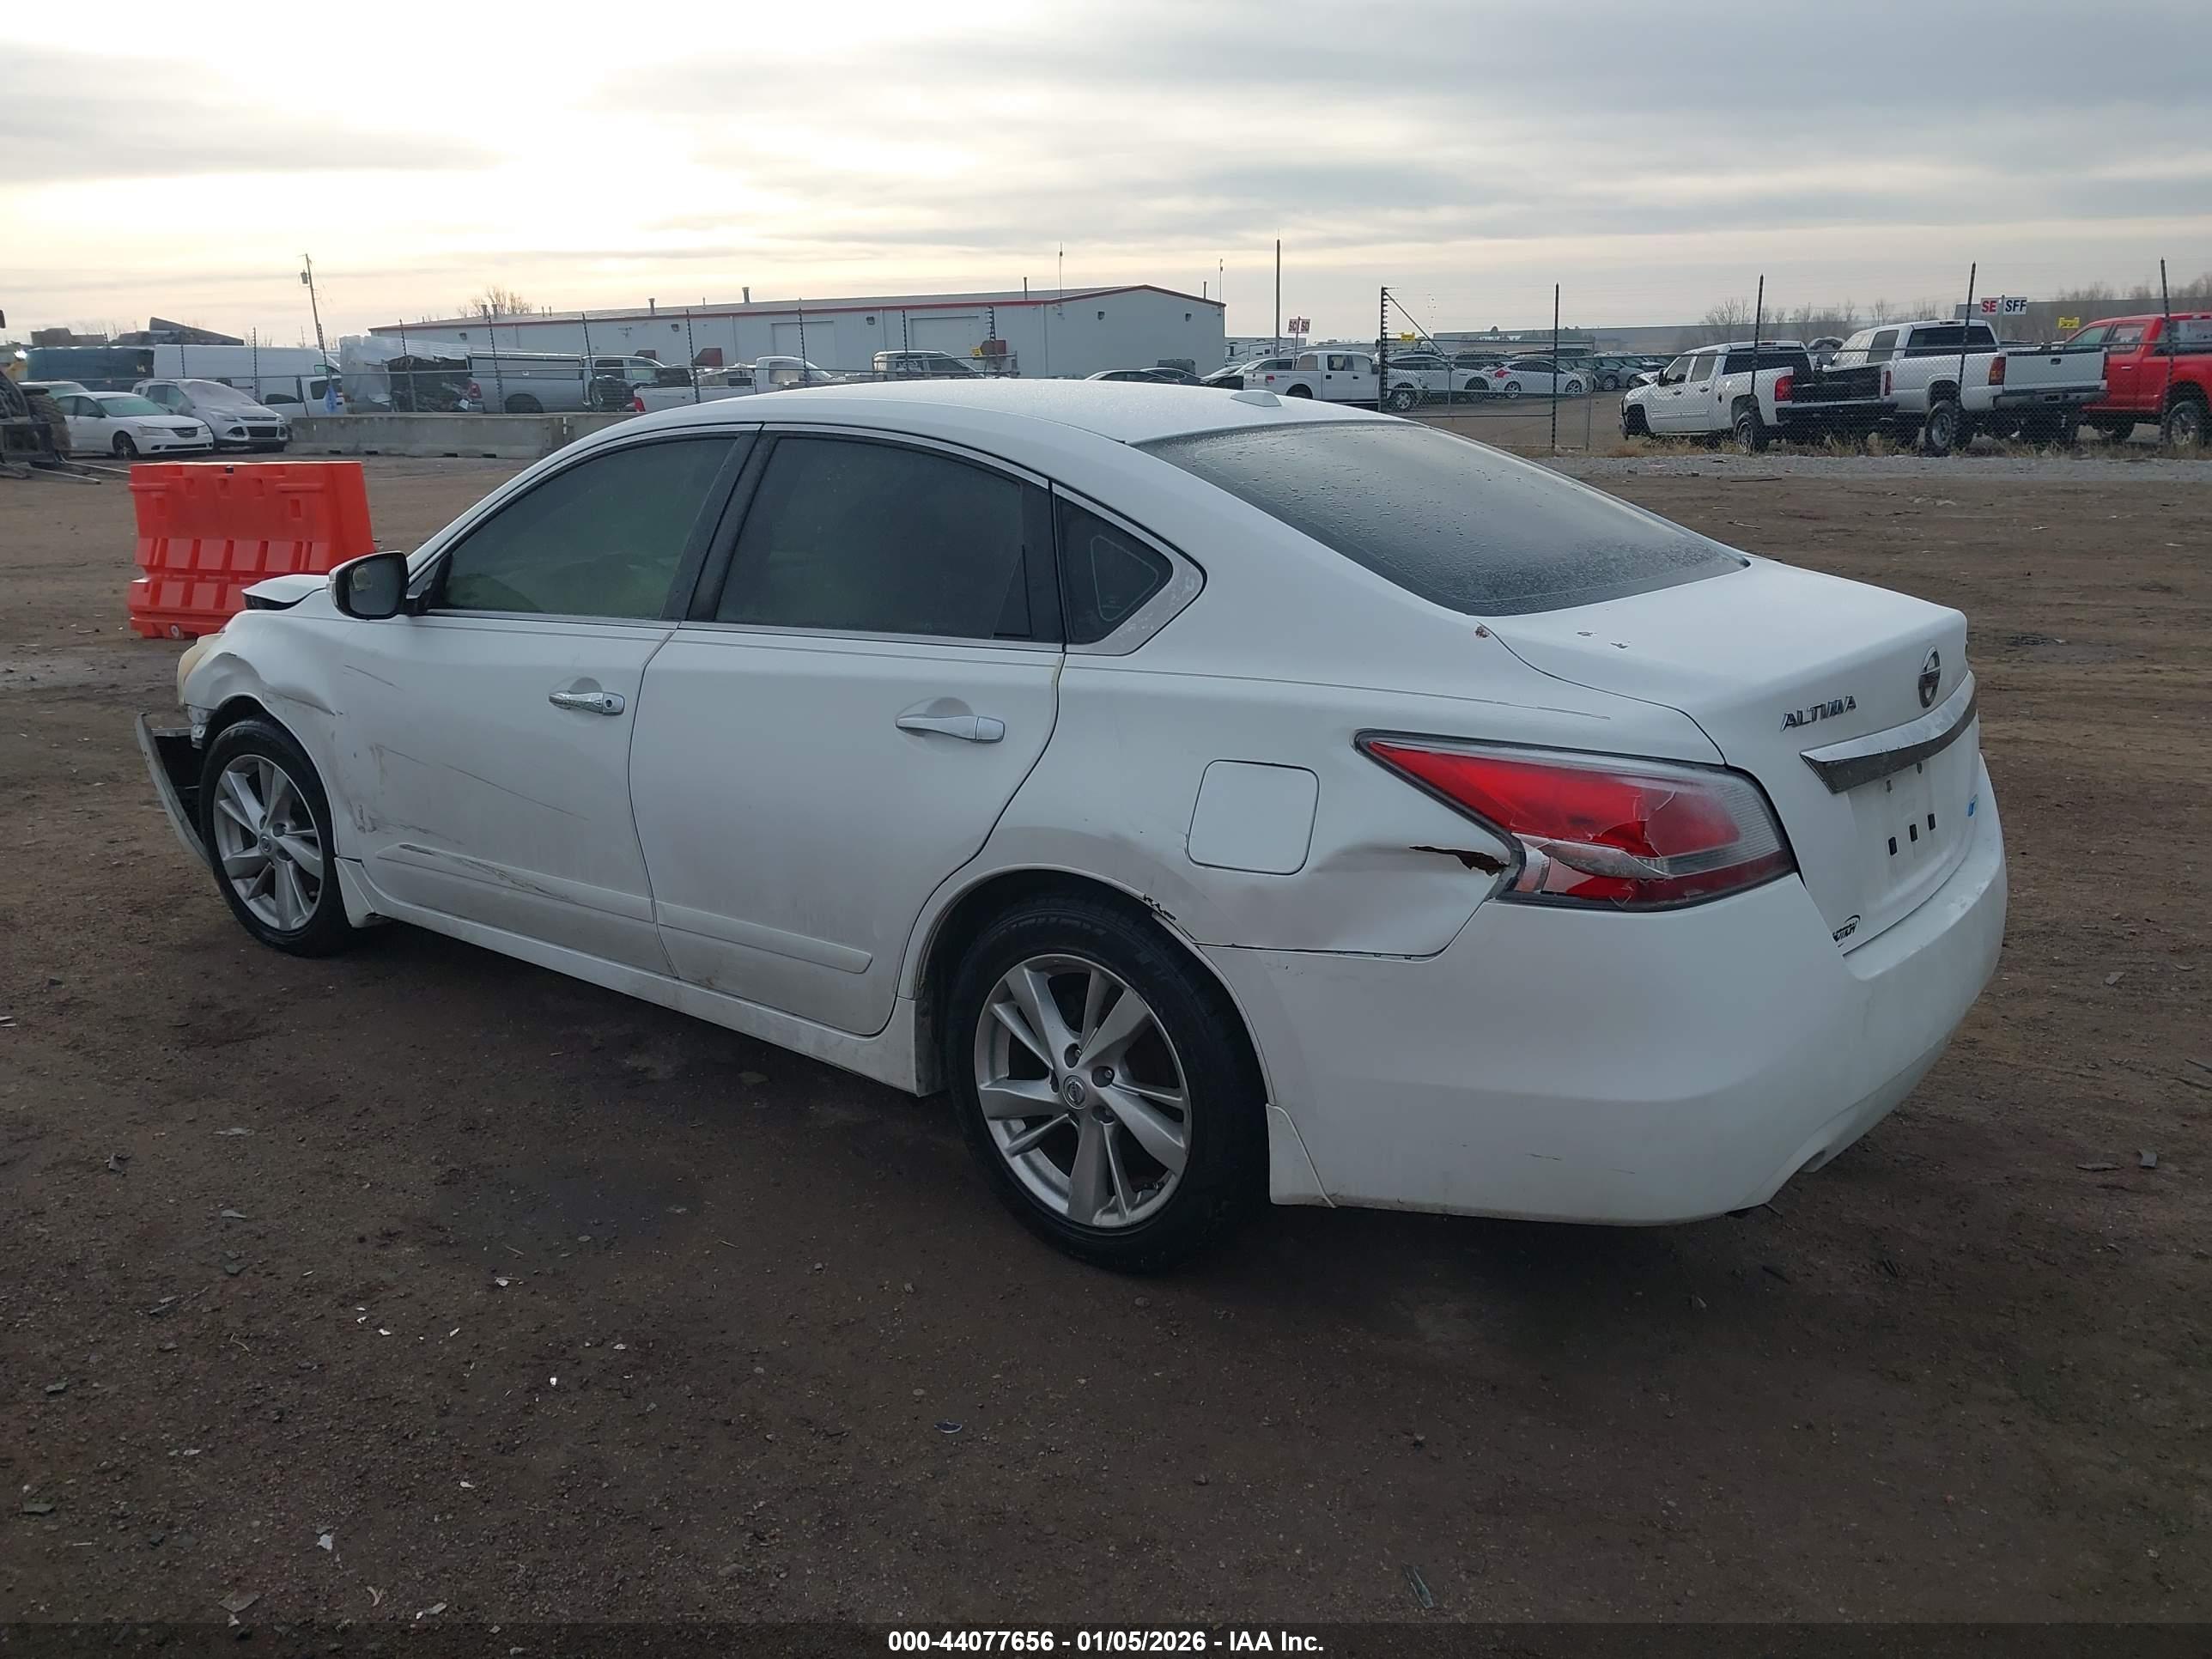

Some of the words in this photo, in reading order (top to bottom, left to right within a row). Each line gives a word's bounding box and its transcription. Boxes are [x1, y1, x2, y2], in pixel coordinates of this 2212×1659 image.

[1981, 300, 1997, 313] SE
[2005, 299, 2027, 313] SFF
[1779, 694, 1857, 732] ALTIMA
